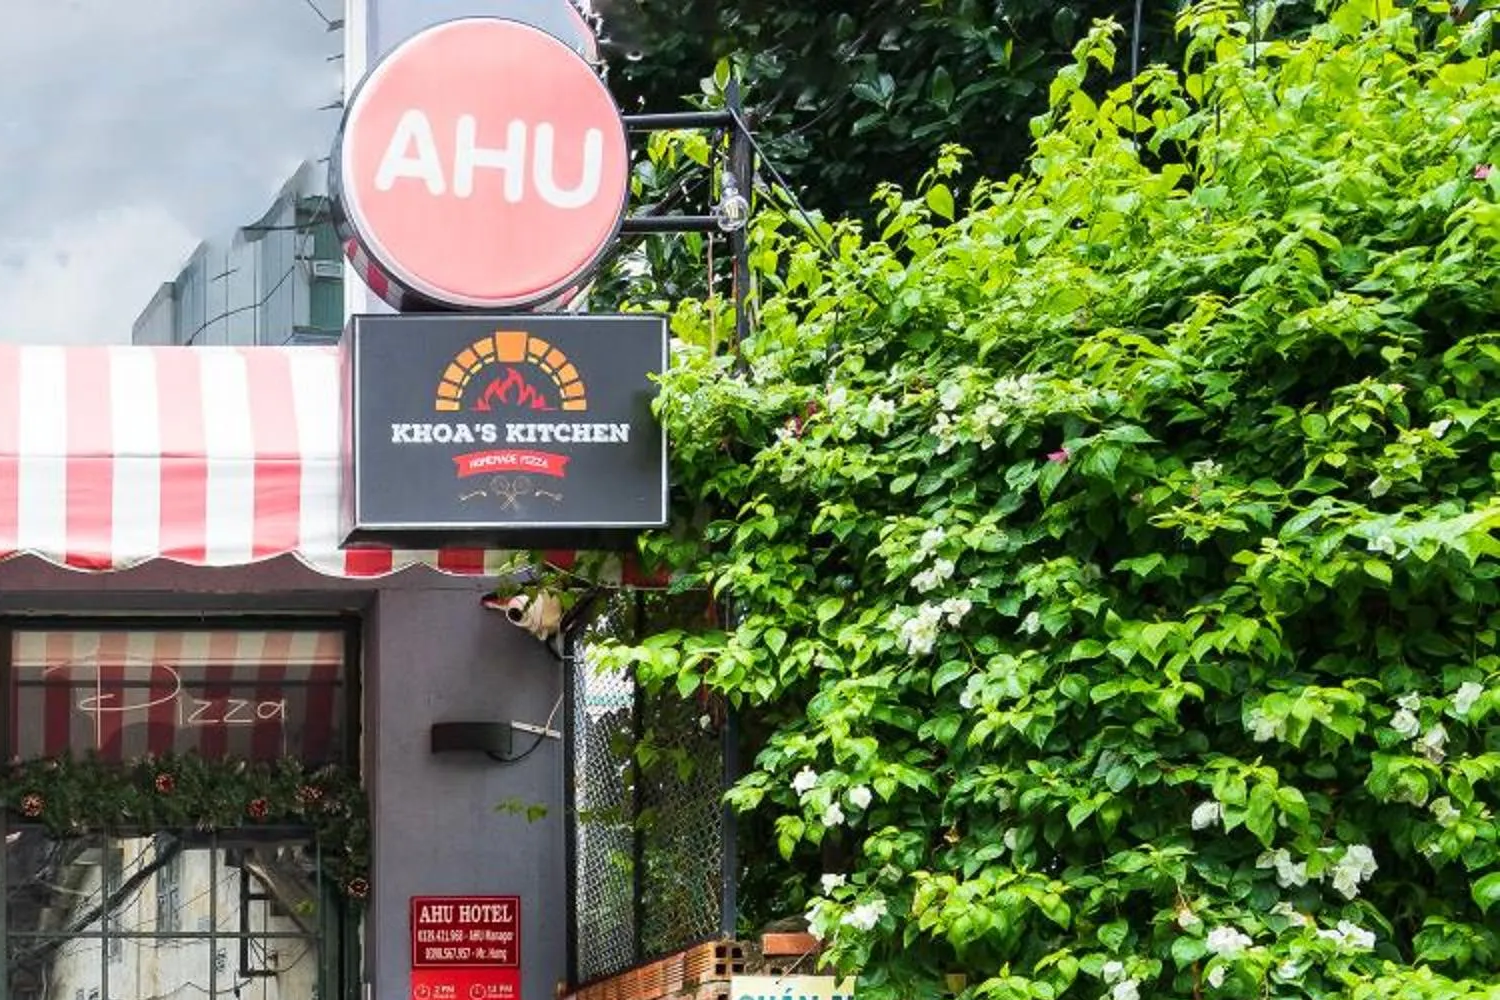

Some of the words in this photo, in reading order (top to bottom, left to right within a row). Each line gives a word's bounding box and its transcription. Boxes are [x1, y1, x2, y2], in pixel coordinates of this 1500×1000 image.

[374, 108, 604, 210] AHU
[391, 423, 498, 444] KHOA'S
[505, 423, 631, 444] KITCHEN
[42, 655, 287, 751] Pizza
[420, 905, 454, 924] AHU
[459, 904, 513, 924] HOTEL
